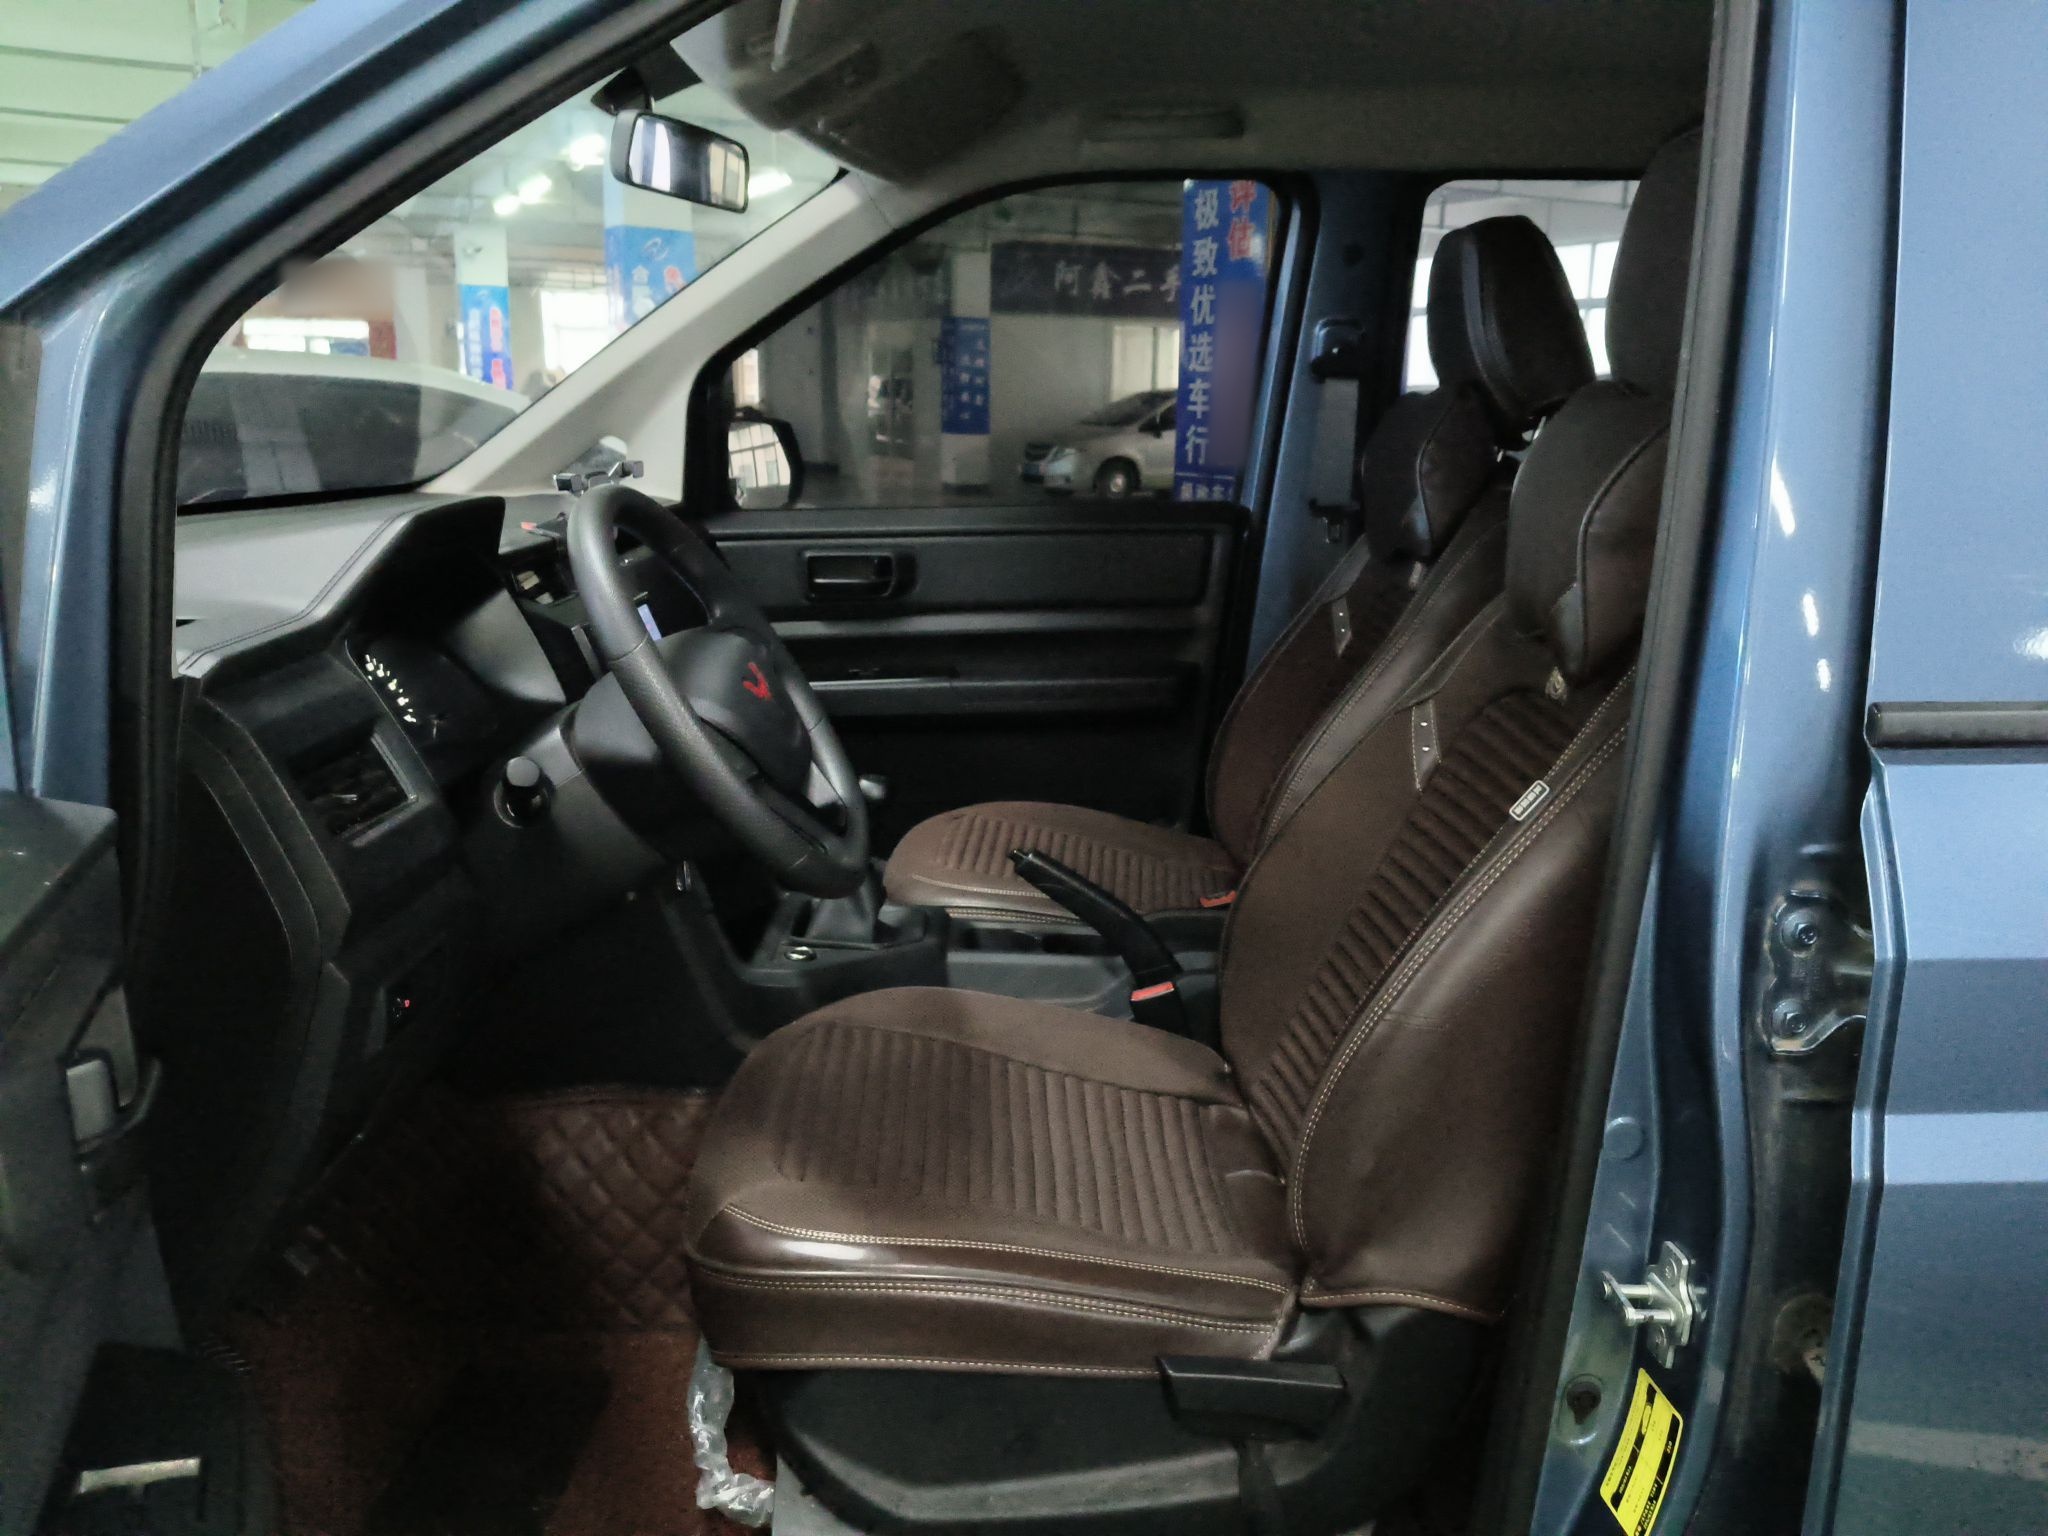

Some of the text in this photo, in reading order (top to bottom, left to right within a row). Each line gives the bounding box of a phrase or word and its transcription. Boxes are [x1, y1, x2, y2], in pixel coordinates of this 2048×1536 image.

[1185, 187, 1219, 465] 极致优选车行
